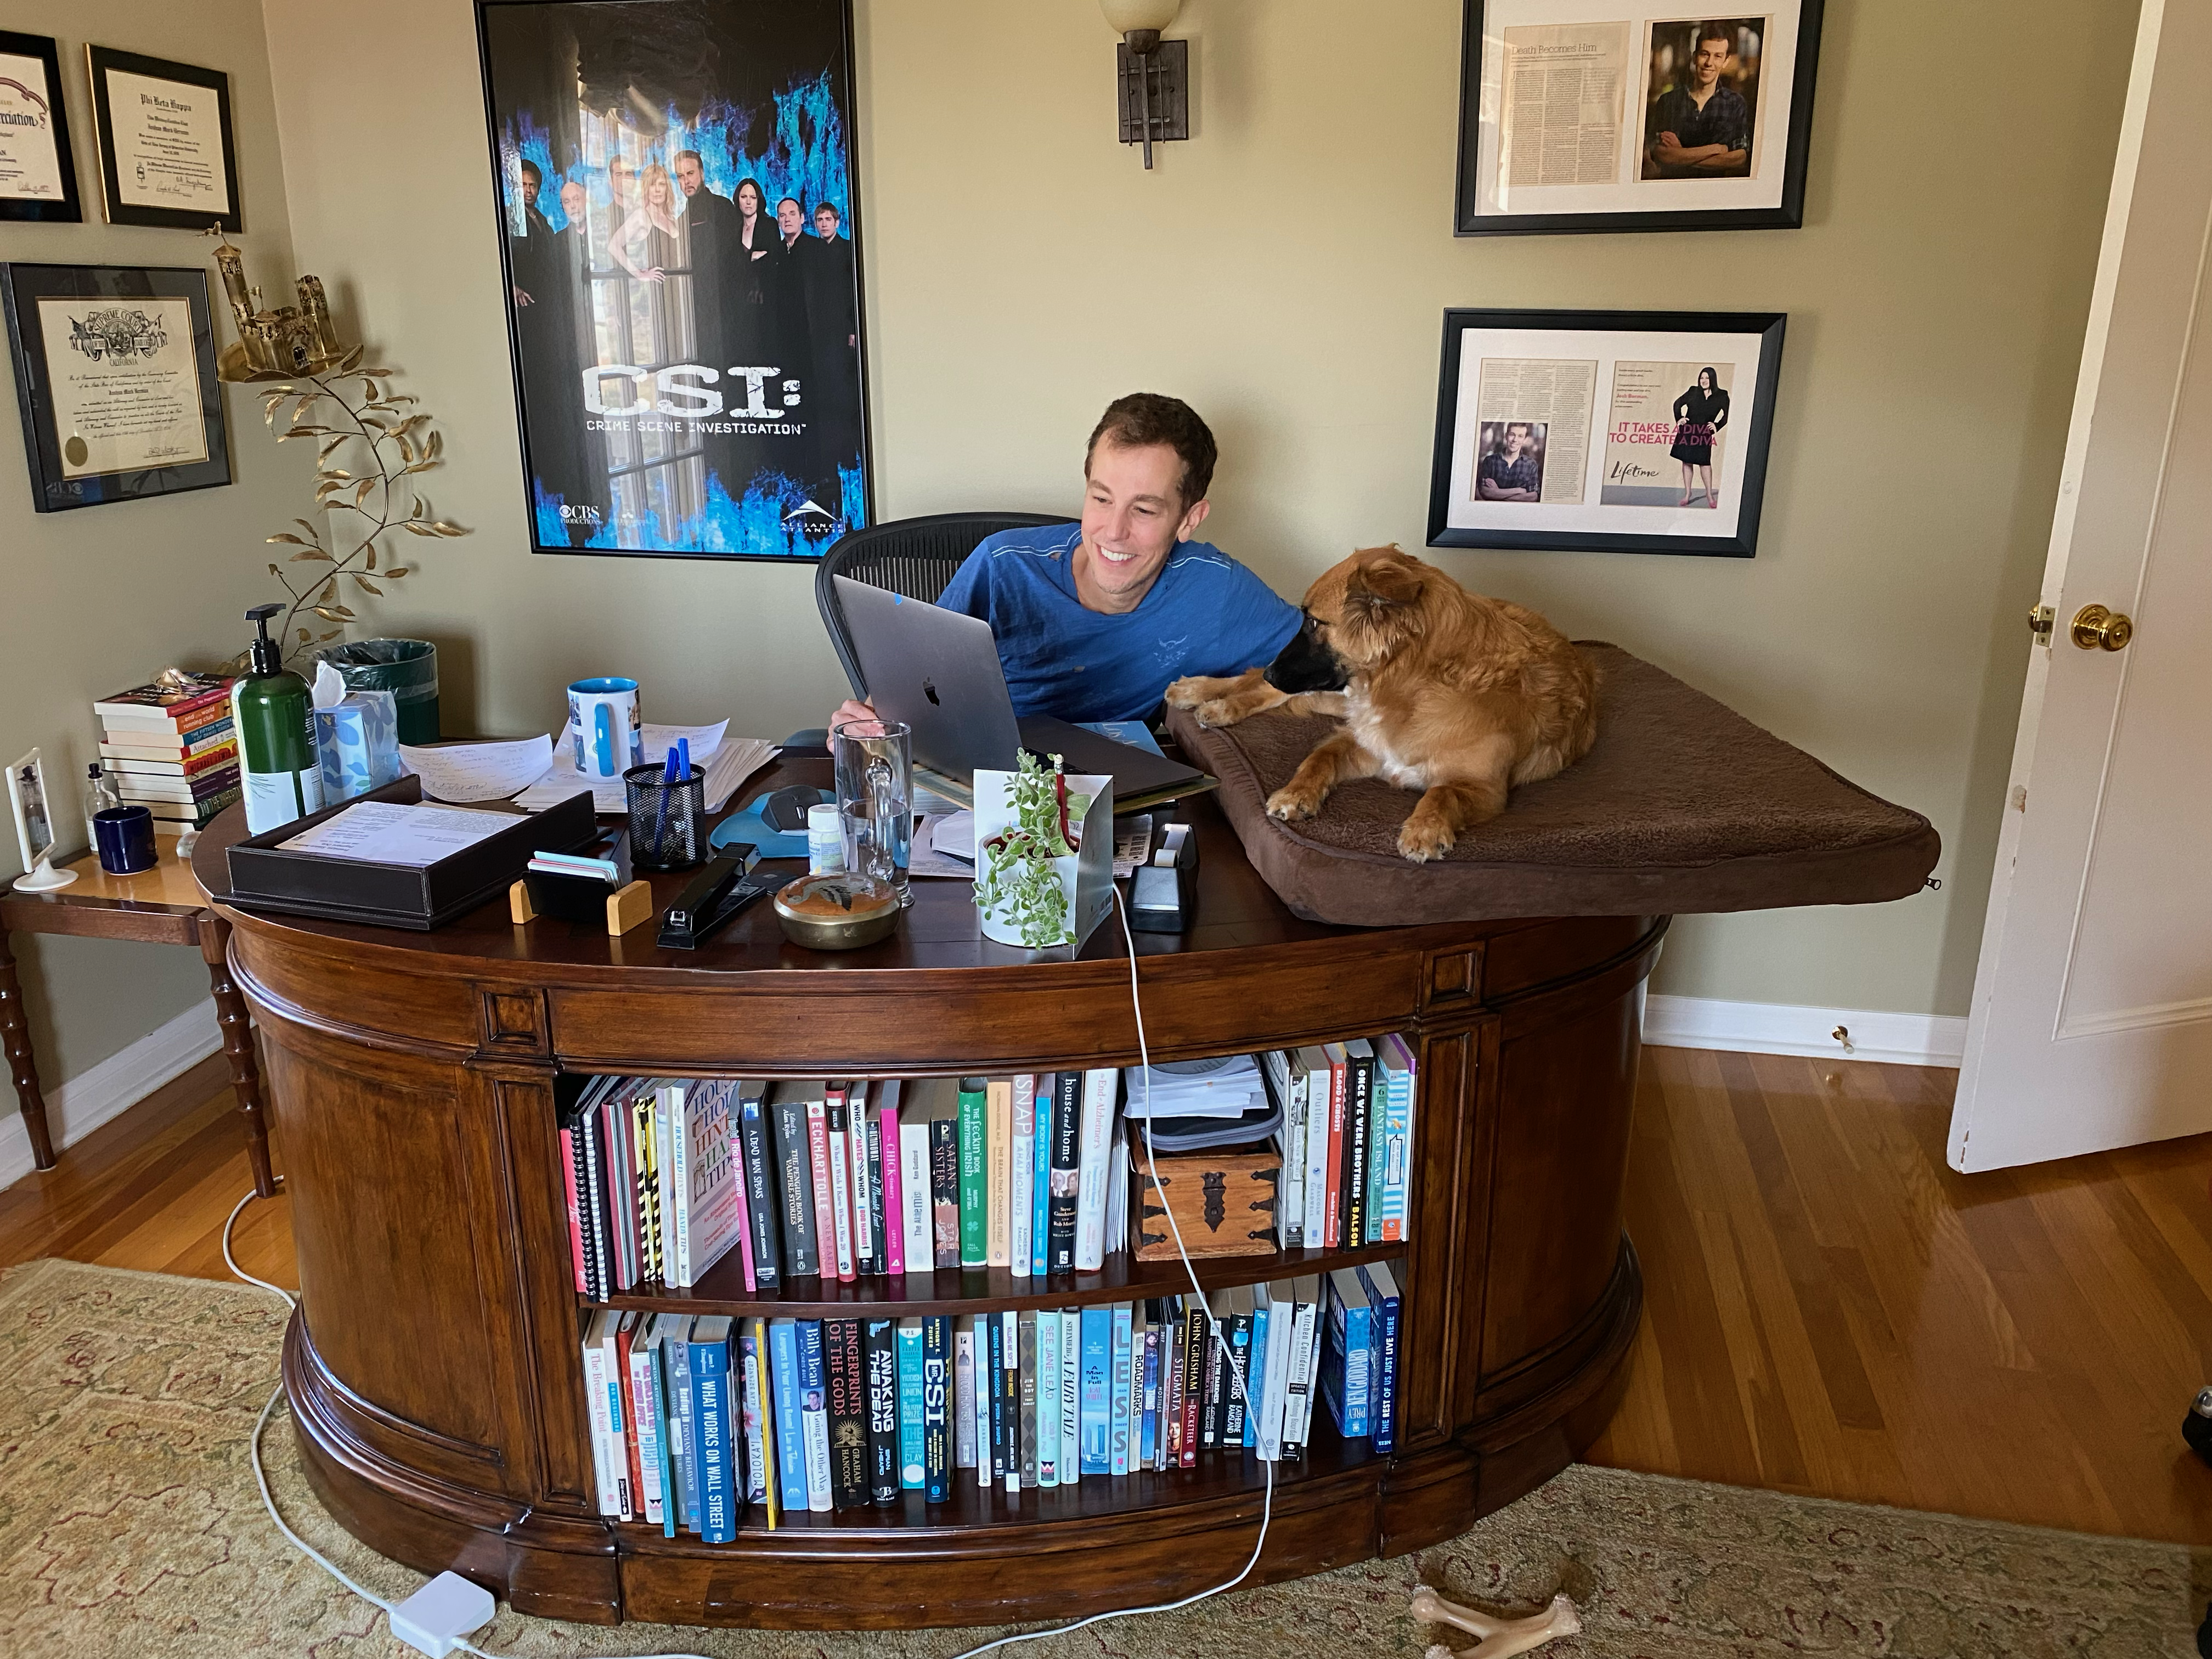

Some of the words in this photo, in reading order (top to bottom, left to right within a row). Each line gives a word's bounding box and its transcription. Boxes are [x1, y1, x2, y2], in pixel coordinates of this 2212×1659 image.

[1512, 46, 1536, 54] Death
[1538, 45, 1577, 54] Becomes
[1578, 43, 1597, 52] Him
[140, 93, 153, 105] Phi
[153, 96, 169, 108] Beta
[170, 99, 191, 111] Kappa
[93, 309, 120, 331] SUPREME
[120, 312, 142, 332] COURT
[110, 358, 138, 366] CALIFORNIA
[582, 364, 801, 419] CSI:
[586, 420, 631, 432] CRIME
[637, 421, 683, 432] SCENE
[1618, 422, 1630, 432] IT
[1632, 422, 1669, 433] TAKES
[1672, 424, 1681, 434] A
[1683, 424, 1711, 435] DIVA
[1610, 433, 1627, 443] TO
[1629, 433, 1676, 445] CREATE
[1679, 436, 1688, 446] A
[1690, 436, 1718, 447] DIVA
[1610, 461, 1659, 484] Lifetime
[572, 505, 600, 518] CBS
[183, 719, 202, 730] running
[202, 714, 215, 722] club
[201, 706, 215, 715] world
[199, 725, 215, 735] FIFTEEN
[1357, 1069, 1366, 1096] ONCE
[1015, 1079, 1034, 1134] SNAP
[1064, 1078, 1077, 1113] house
[1357, 1098, 1365, 1115] WE
[853, 1104, 861, 1121] WHO
[1063, 1114, 1071, 1128] and
[1313, 1093, 1324, 1134] Outliers
[782, 1124, 791, 1138] Ryan
[1355, 1117, 1364, 1145] WERE
[1375, 1105, 1385, 1148] FANTASY
[731, 1143, 740, 1156] Rio
[750, 1137, 759, 1155] DEAD
[791, 1149, 799, 1164] THE
[811, 1121, 826, 1176] ECKHART
[868, 1131, 879, 1161] HEMINGWAY
[1015, 1146, 1023, 1169] AHA!
[1062, 1130, 1074, 1162] home
[733, 1157, 741, 1167] de
[752, 1158, 761, 1173] MAN
[935, 1147, 945, 1188] SISTERS
[946, 1143, 956, 1189] SATAN'S
[1352, 1148, 1362, 1198] BROTHERS
[1374, 1150, 1383, 1185] ISLAND
[733, 1169, 744, 1198] Janeiro
[753, 1176, 763, 1199] SPEAKS
[786, 1159, 794, 1192] VAMPIRE
[792, 1166, 801, 1199] PENGUIN
[816, 1176, 828, 1211] TOLLE
[1014, 1171, 1023, 1216] MOMENTS
[679, 1209, 687, 1234] HANDY
[787, 1194, 797, 1226] STORIES
[794, 1201, 803, 1222] BOOK
[797, 1223, 805, 1234] OF
[939, 1218, 947, 1255] JONES
[1350, 1206, 1360, 1246] BALSON
[826, 1243, 834, 1272] EARTH
[829, 1324, 841, 1342] OF
[1046, 1326, 1054, 1344] SEE
[1192, 1314, 1201, 1341] JOHN
[1301, 1314, 1312, 1339] Kitchen
[1386, 1316, 1395, 1336] HERE
[805, 1328, 821, 1356] Billy
[1385, 1338, 1393, 1355] LIVE
[591, 1353, 601, 1370] The
[831, 1346, 843, 1373] THE
[845, 1323, 861, 1414] FINGERPRINTS
[870, 1350, 881, 1385] THE
[1046, 1347, 1054, 1372] JANE
[1064, 1356, 1075, 1365] A
[1189, 1345, 1202, 1390] GRISHAM
[1297, 1342, 1309, 1383] Confidential
[1347, 1349, 1368, 1389] GODDARD
[808, 1359, 821, 1386] Bean
[1172, 1358, 1183, 1412] STIGMATA
[1384, 1376, 1391, 1385] US
[592, 1373, 604, 1409] Breaking
[702, 1381, 716, 1408] WHAT
[833, 1378, 845, 1415] GODS
[881, 1350, 894, 1432] AWAKING
[902, 1387, 922, 1397] UNION
[924, 1359, 944, 1426] CSI
[1045, 1375, 1057, 1400] LEAD
[1064, 1369, 1074, 1407] FAIRY
[1132, 1355, 1143, 1416] ROADMARKS
[1347, 1390, 1368, 1406] KEN
[1383, 1387, 1391, 1397] OF
[871, 1388, 882, 1432] DEAD
[1227, 1404, 1235, 1433] RAMSLAND
[1234, 1405, 1243, 1433] KATHERINE
[1290, 1396, 1301, 1417] Anthony
[1347, 1407, 1367, 1419] PREY
[1383, 1400, 1391, 1418] REST
[597, 1411, 607, 1432] Point
[703, 1411, 719, 1447] WORKS
[812, 1414, 824, 1436] Going
[905, 1427, 922, 1440] THE
[1064, 1404, 1074, 1440] TALE
[1289, 1418, 1298, 1441] Bourdain
[1381, 1420, 1390, 1433] THE
[706, 1450, 720, 1463] ON
[815, 1438, 826, 1451] the
[752, 1441, 763, 1486] MOLOKA'I
[817, 1453, 827, 1473] Other
[842, 1449, 851, 1488] HANCOCK
[853, 1448, 861, 1483] GRAHAM
[905, 1454, 922, 1463] CLAY
[707, 1465, 721, 1493] WALL
[817, 1475, 828, 1492] Way
[708, 1495, 724, 1529] STREET
